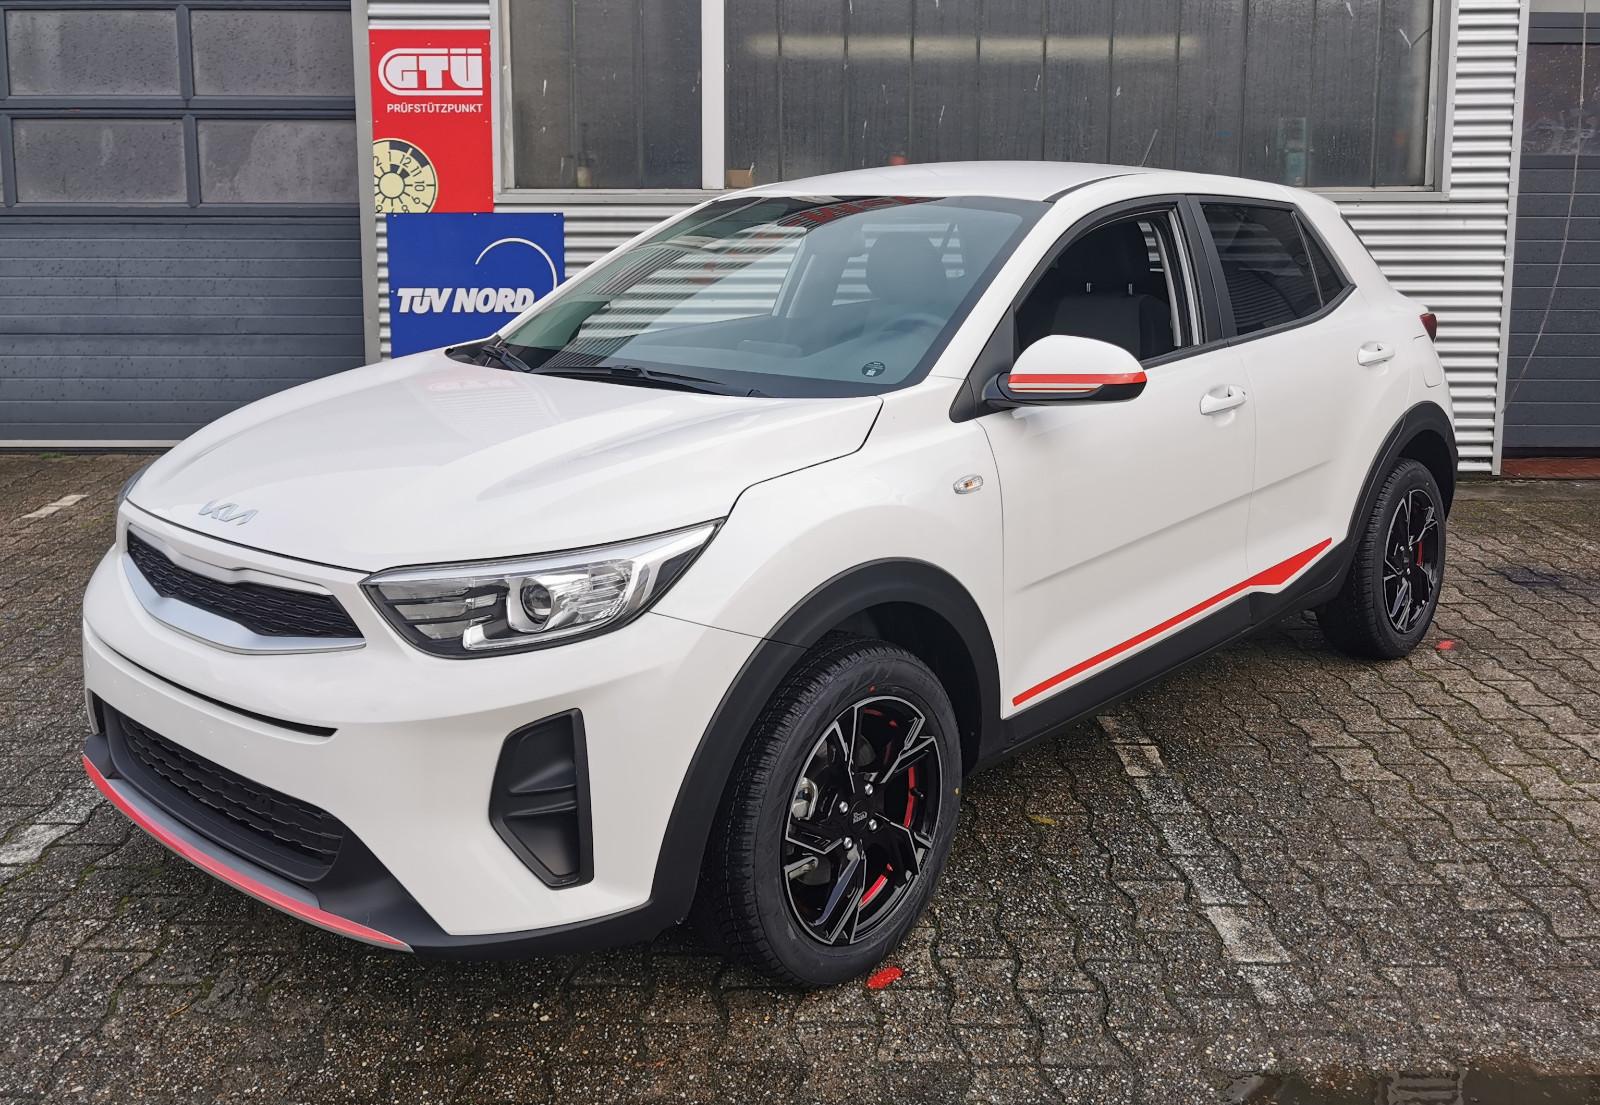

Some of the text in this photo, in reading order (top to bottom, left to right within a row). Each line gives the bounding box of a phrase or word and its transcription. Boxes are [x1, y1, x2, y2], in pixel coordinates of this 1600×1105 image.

[378, 48, 483, 96] GTÜ
[386, 101, 484, 114] PRÜFSTÜTZPUNKT
[373, 155, 382, 167] 2
[388, 151, 392, 162] 1
[400, 154, 412, 168] 12
[410, 166, 422, 177] 11
[414, 181, 425, 192] 10
[397, 287, 535, 314] TÜV NORD
